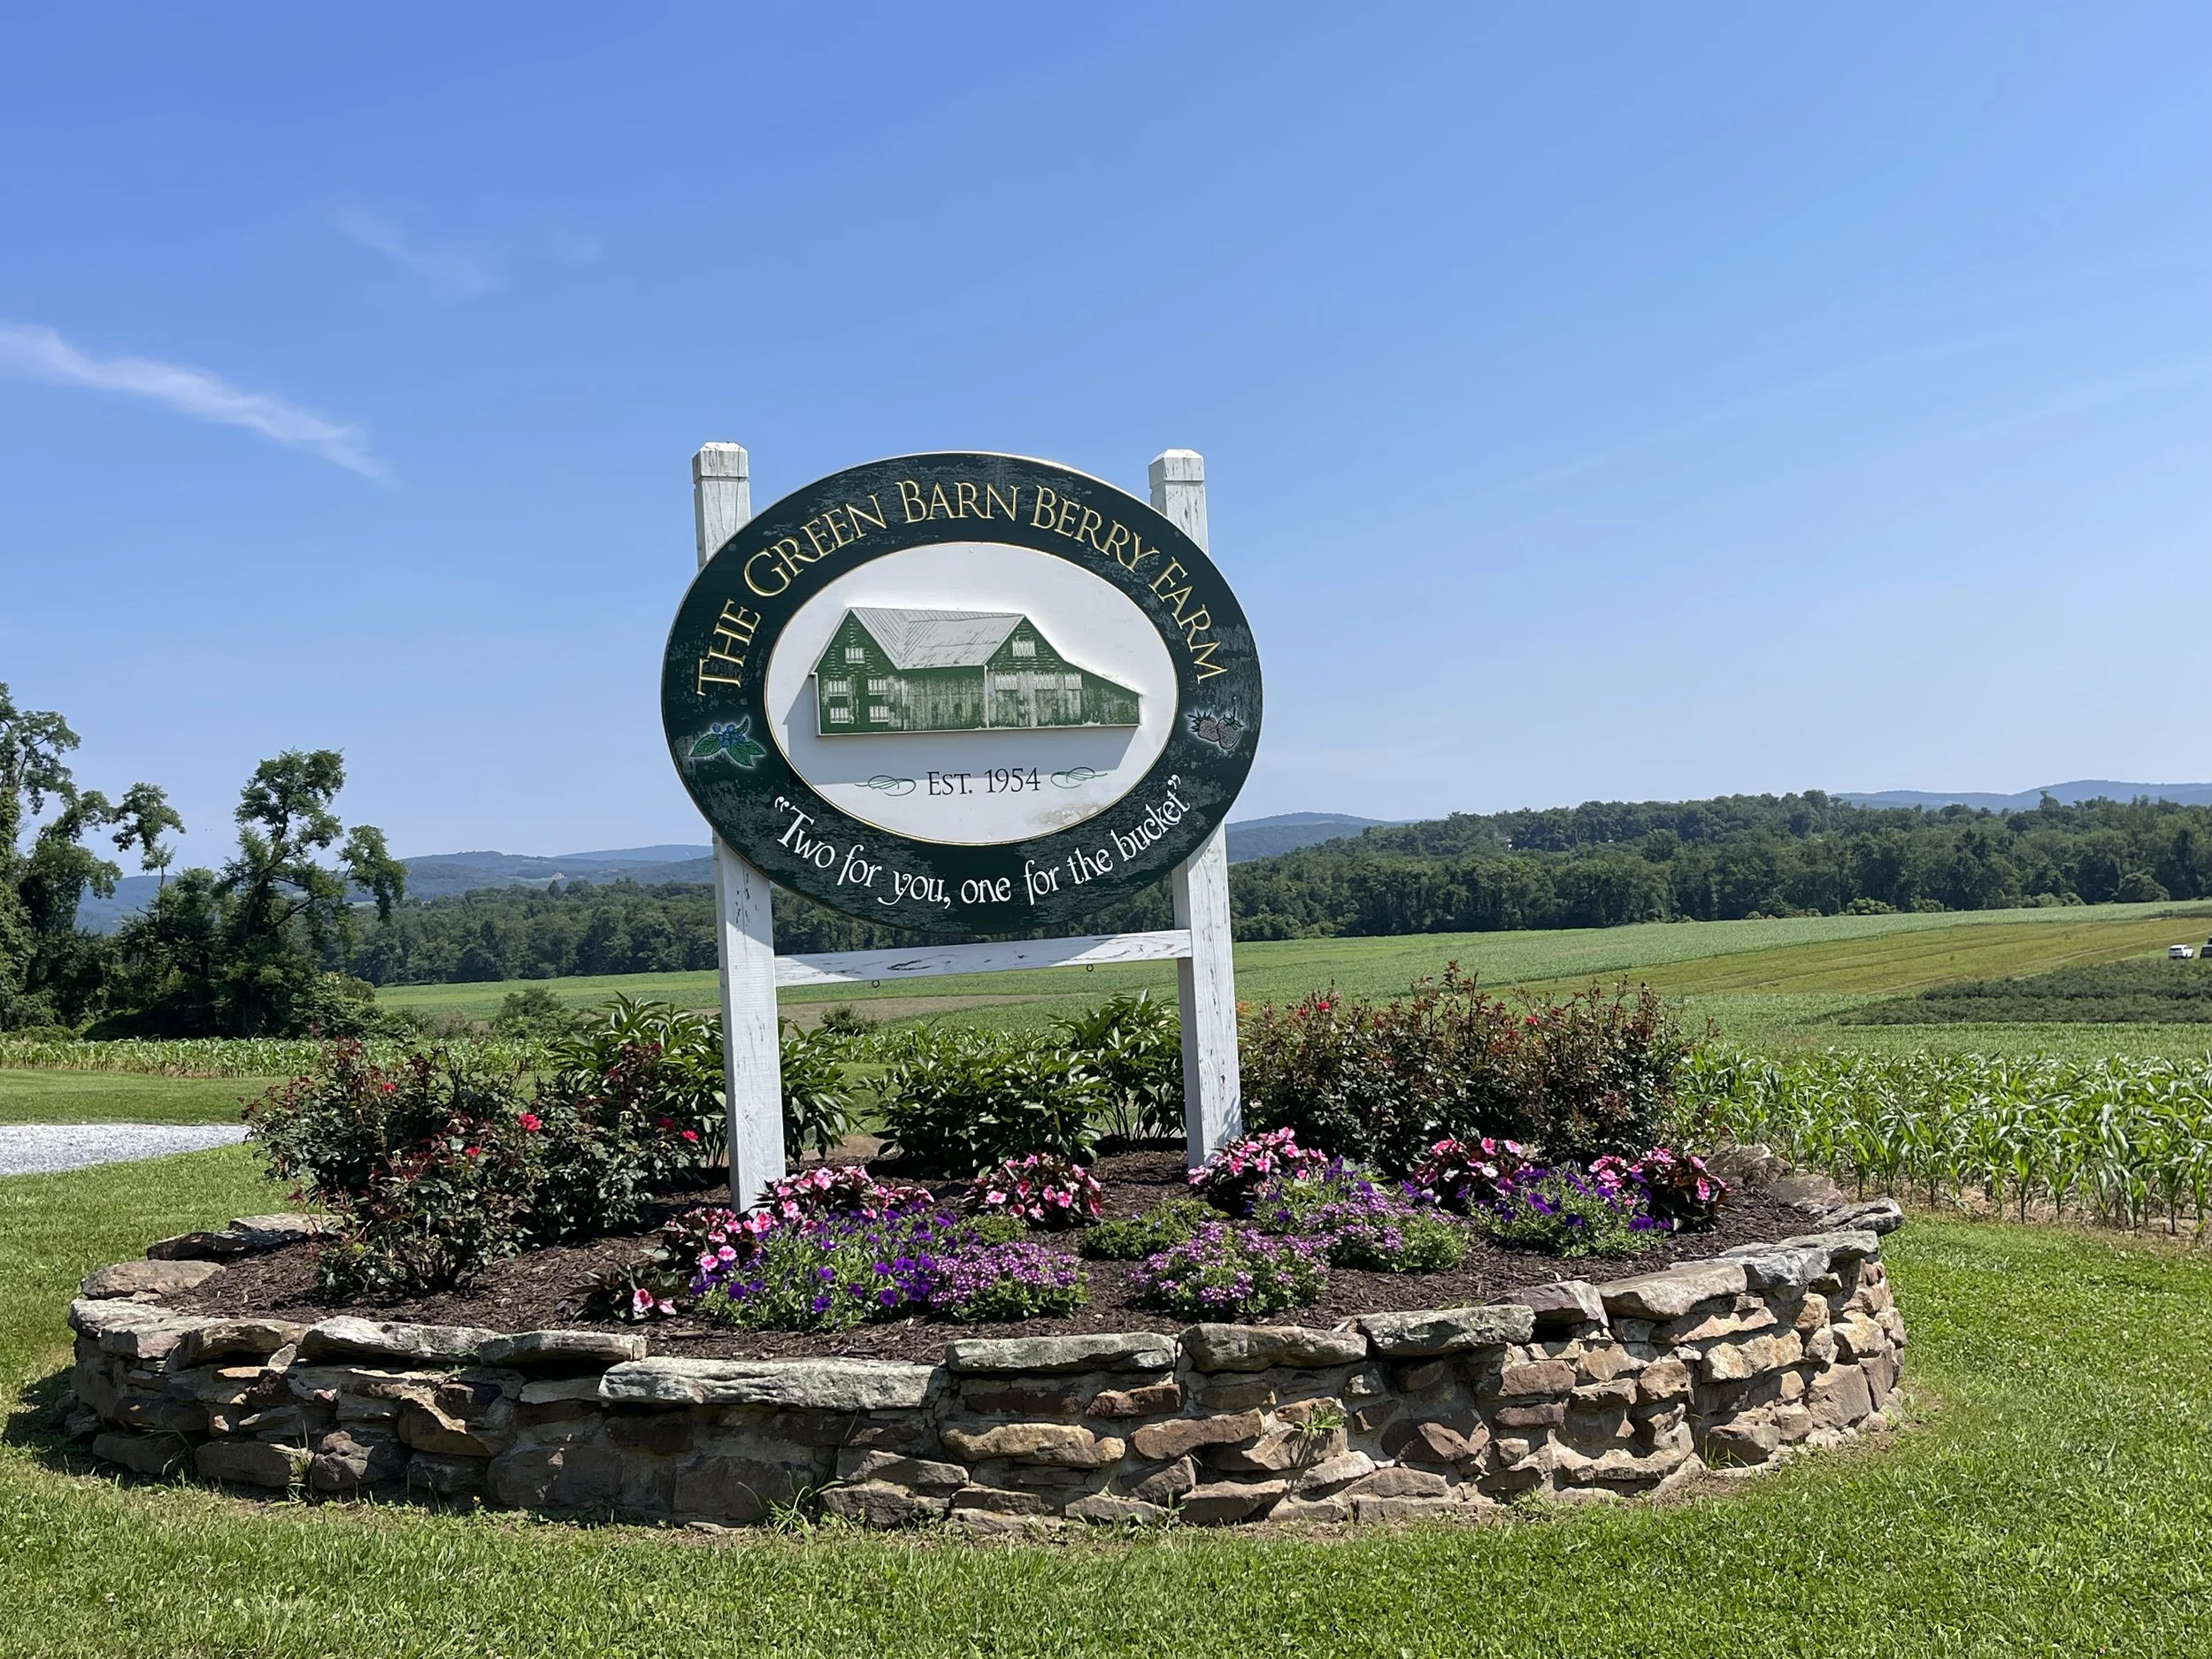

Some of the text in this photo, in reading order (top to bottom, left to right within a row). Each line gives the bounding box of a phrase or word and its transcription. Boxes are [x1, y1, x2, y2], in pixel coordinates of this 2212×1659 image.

[985, 767, 1041, 794] 1954
[836, 844, 883, 887] for
[878, 870, 951, 910] you,
[961, 878, 1012, 904] one
[1023, 860, 1060, 905] for
[1067, 847, 1113, 885] the
